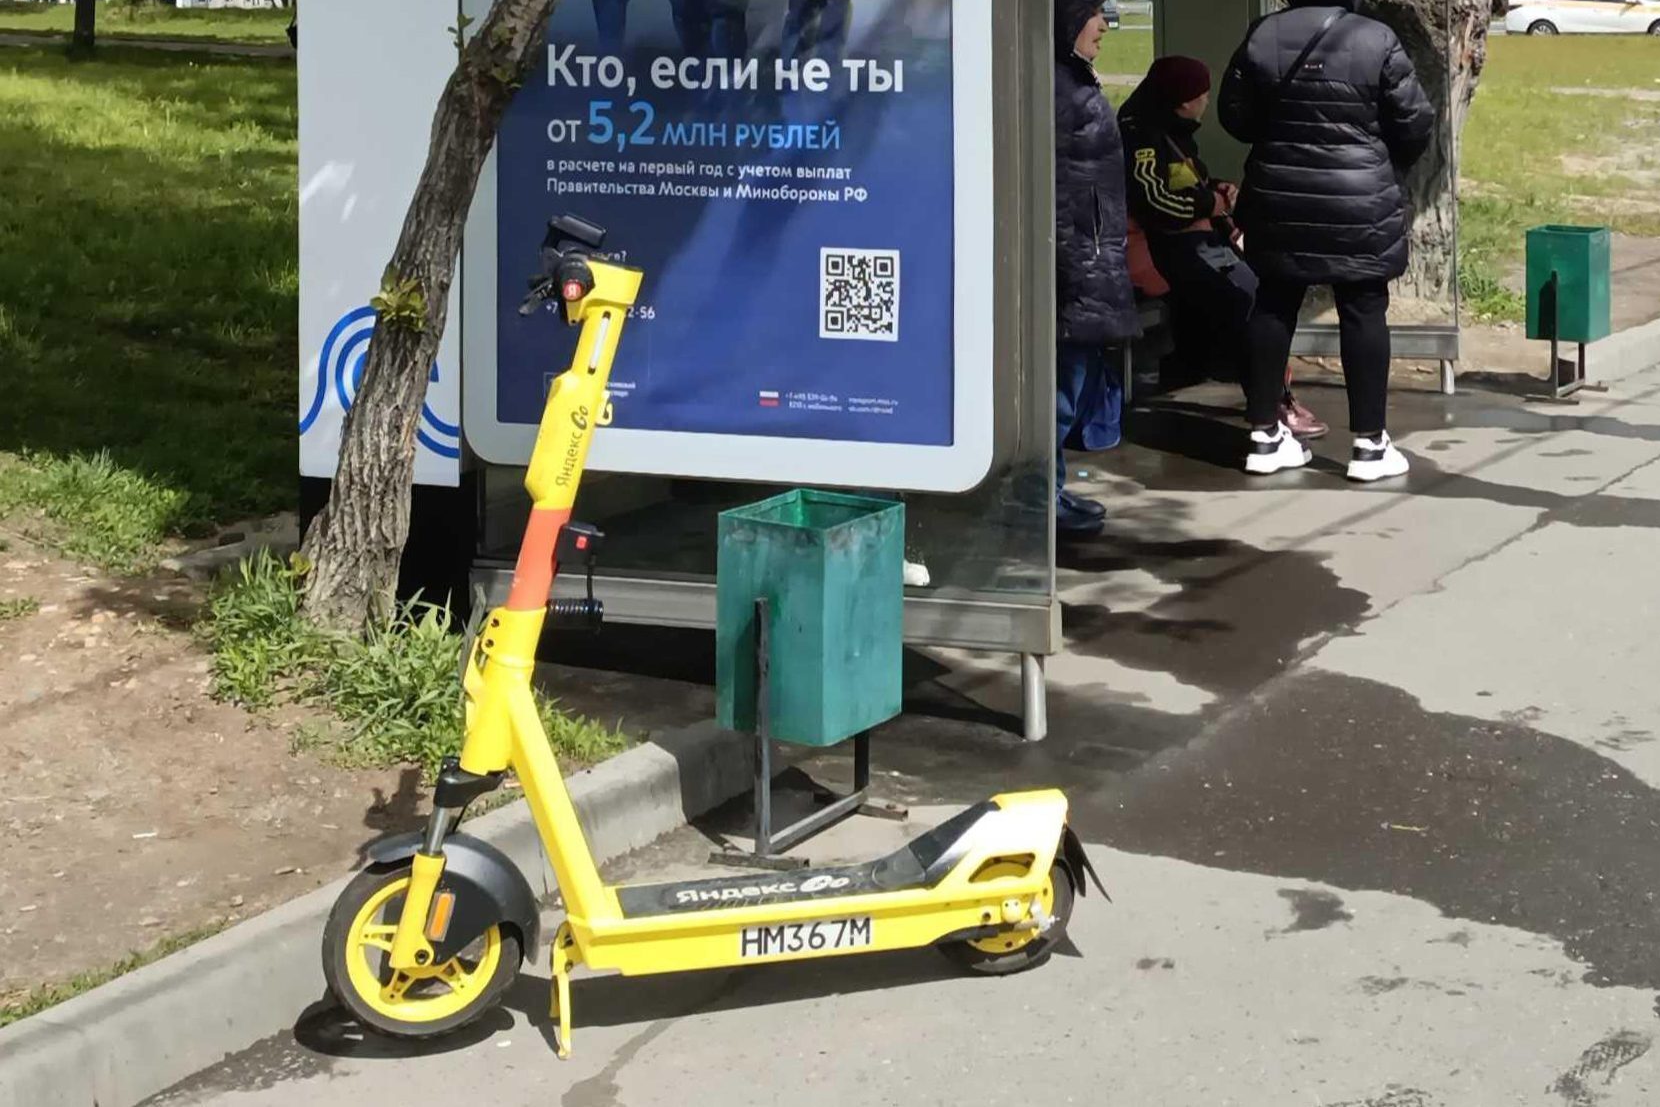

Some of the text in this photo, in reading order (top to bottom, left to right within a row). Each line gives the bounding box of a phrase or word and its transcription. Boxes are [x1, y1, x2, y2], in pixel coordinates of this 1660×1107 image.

[547, 44, 904, 96] Кто, если не ты
[547, 100, 840, 152] от 5,2 МЛН РУБЛЕЙ
[546, 160, 851, 180] в расчете на первый год с учетом выплат
[546, 178, 868, 203] Правительства Москвы и Минобороны РФ
[555, 405, 589, 487] Яндекс Go
[676, 881, 798, 904] Яндекс
